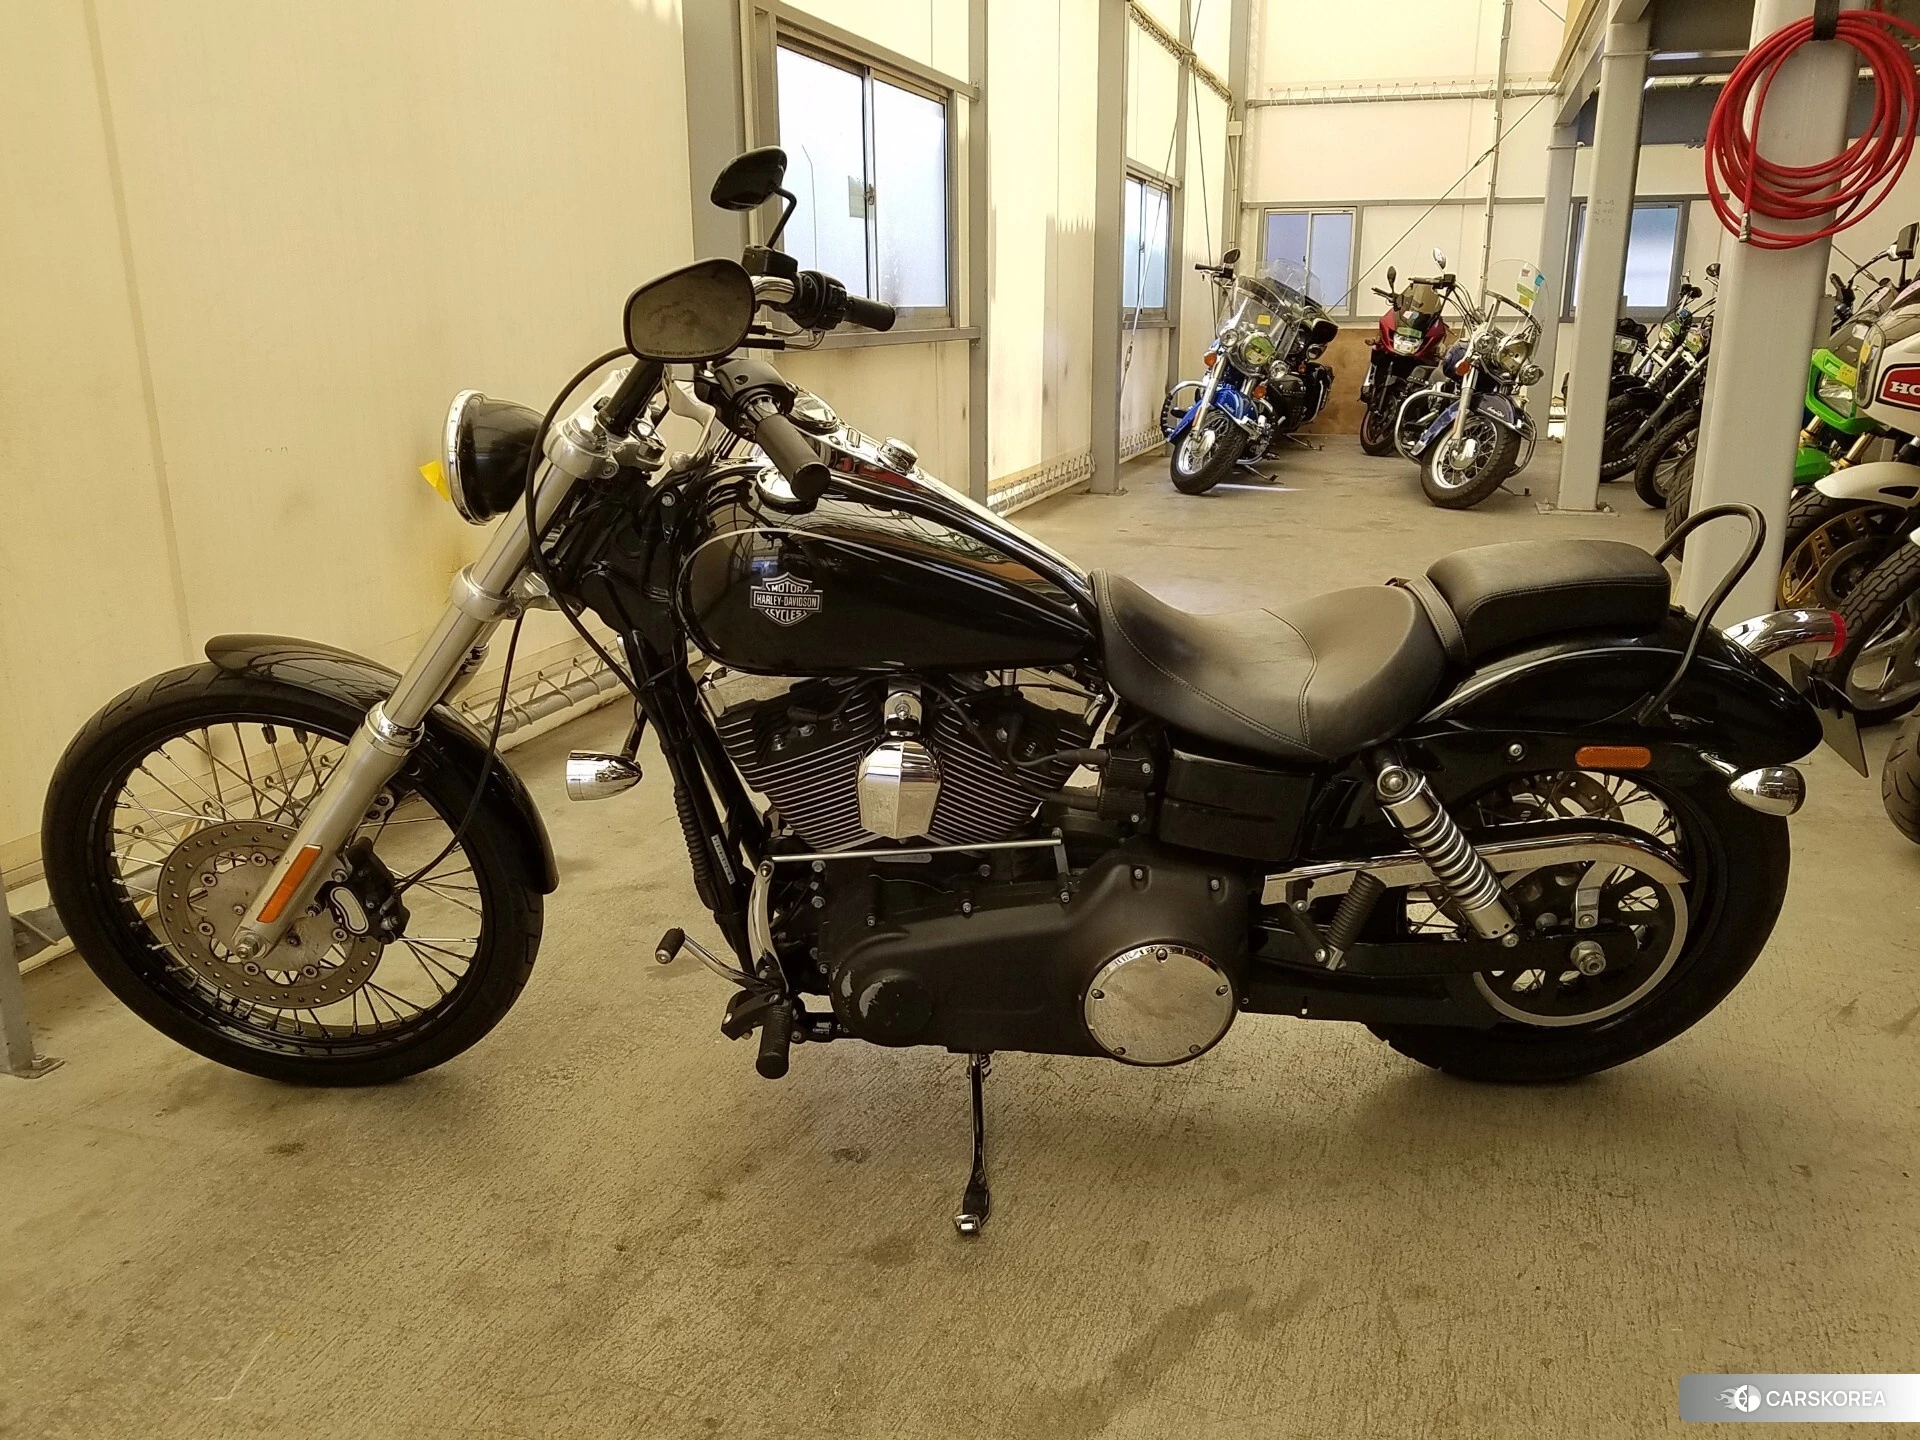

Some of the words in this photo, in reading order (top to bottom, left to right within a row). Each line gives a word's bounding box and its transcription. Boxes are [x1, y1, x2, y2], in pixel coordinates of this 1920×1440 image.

[772, 582, 803, 593] MOTOR
[757, 594, 817, 607] HARLEY-DAVIDSON
[770, 609, 802, 622] CYCLES
